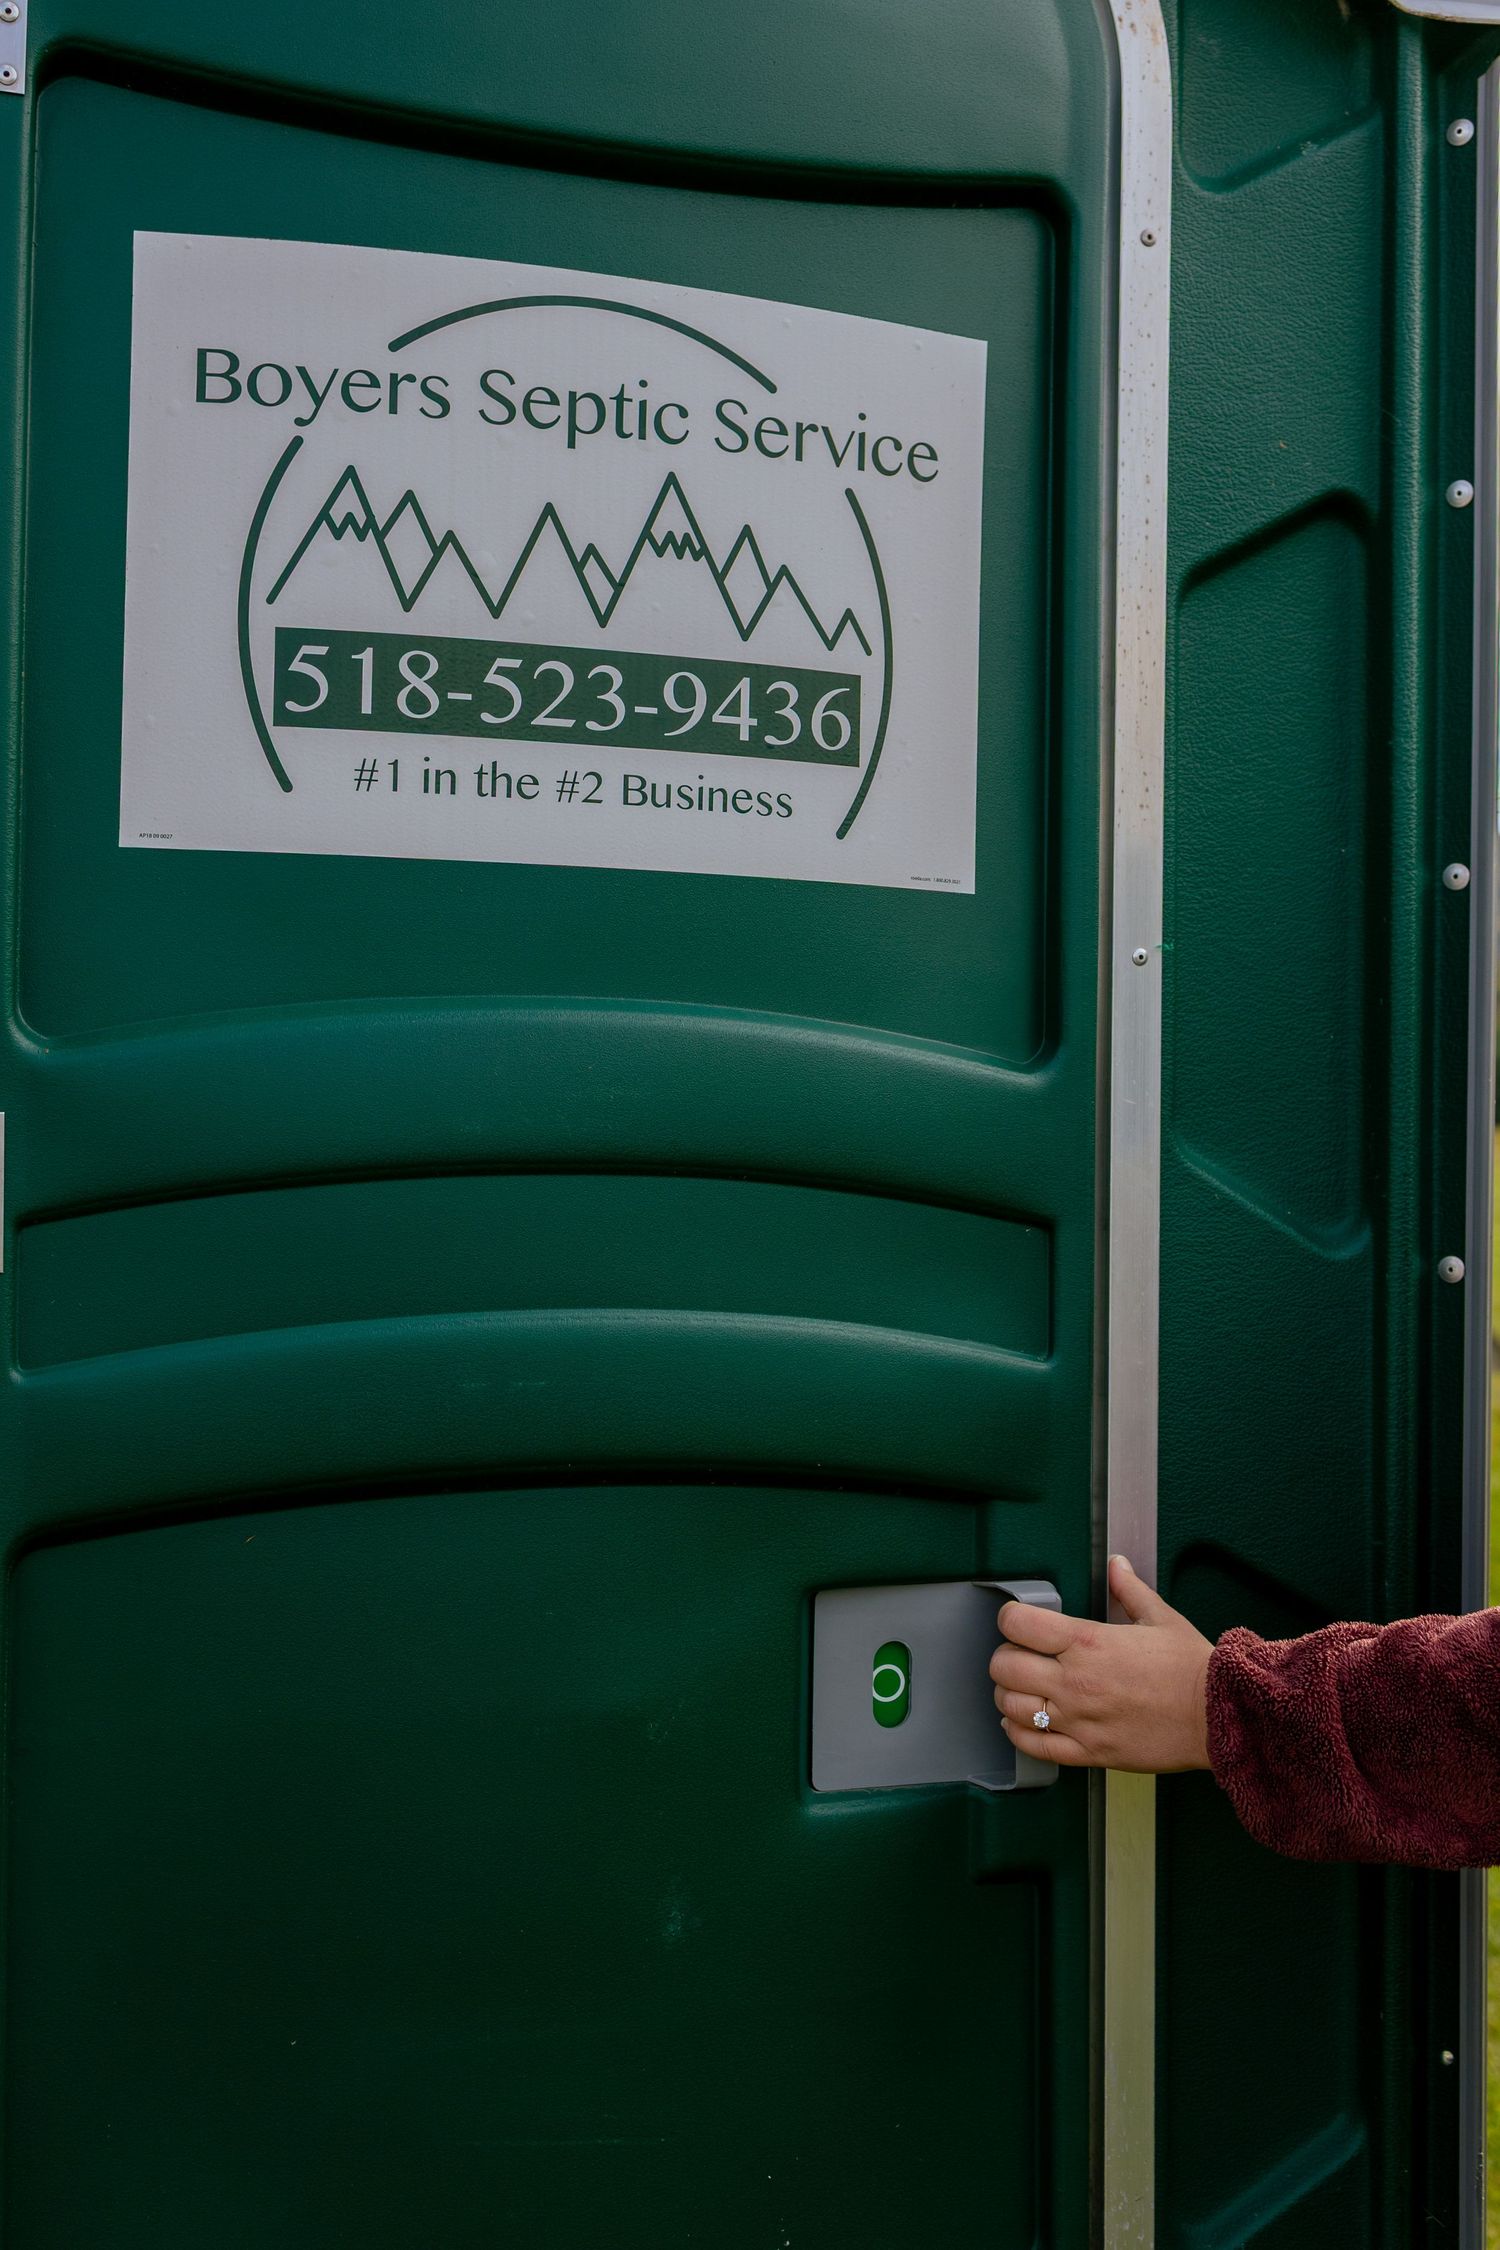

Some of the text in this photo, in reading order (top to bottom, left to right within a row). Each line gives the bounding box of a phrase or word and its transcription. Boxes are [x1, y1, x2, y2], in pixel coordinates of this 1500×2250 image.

[195, 347, 940, 484] Boyers Septic Service
[285, 644, 852, 752] 518-523-9436
[354, 756, 794, 820] #1 in the #2 Business
